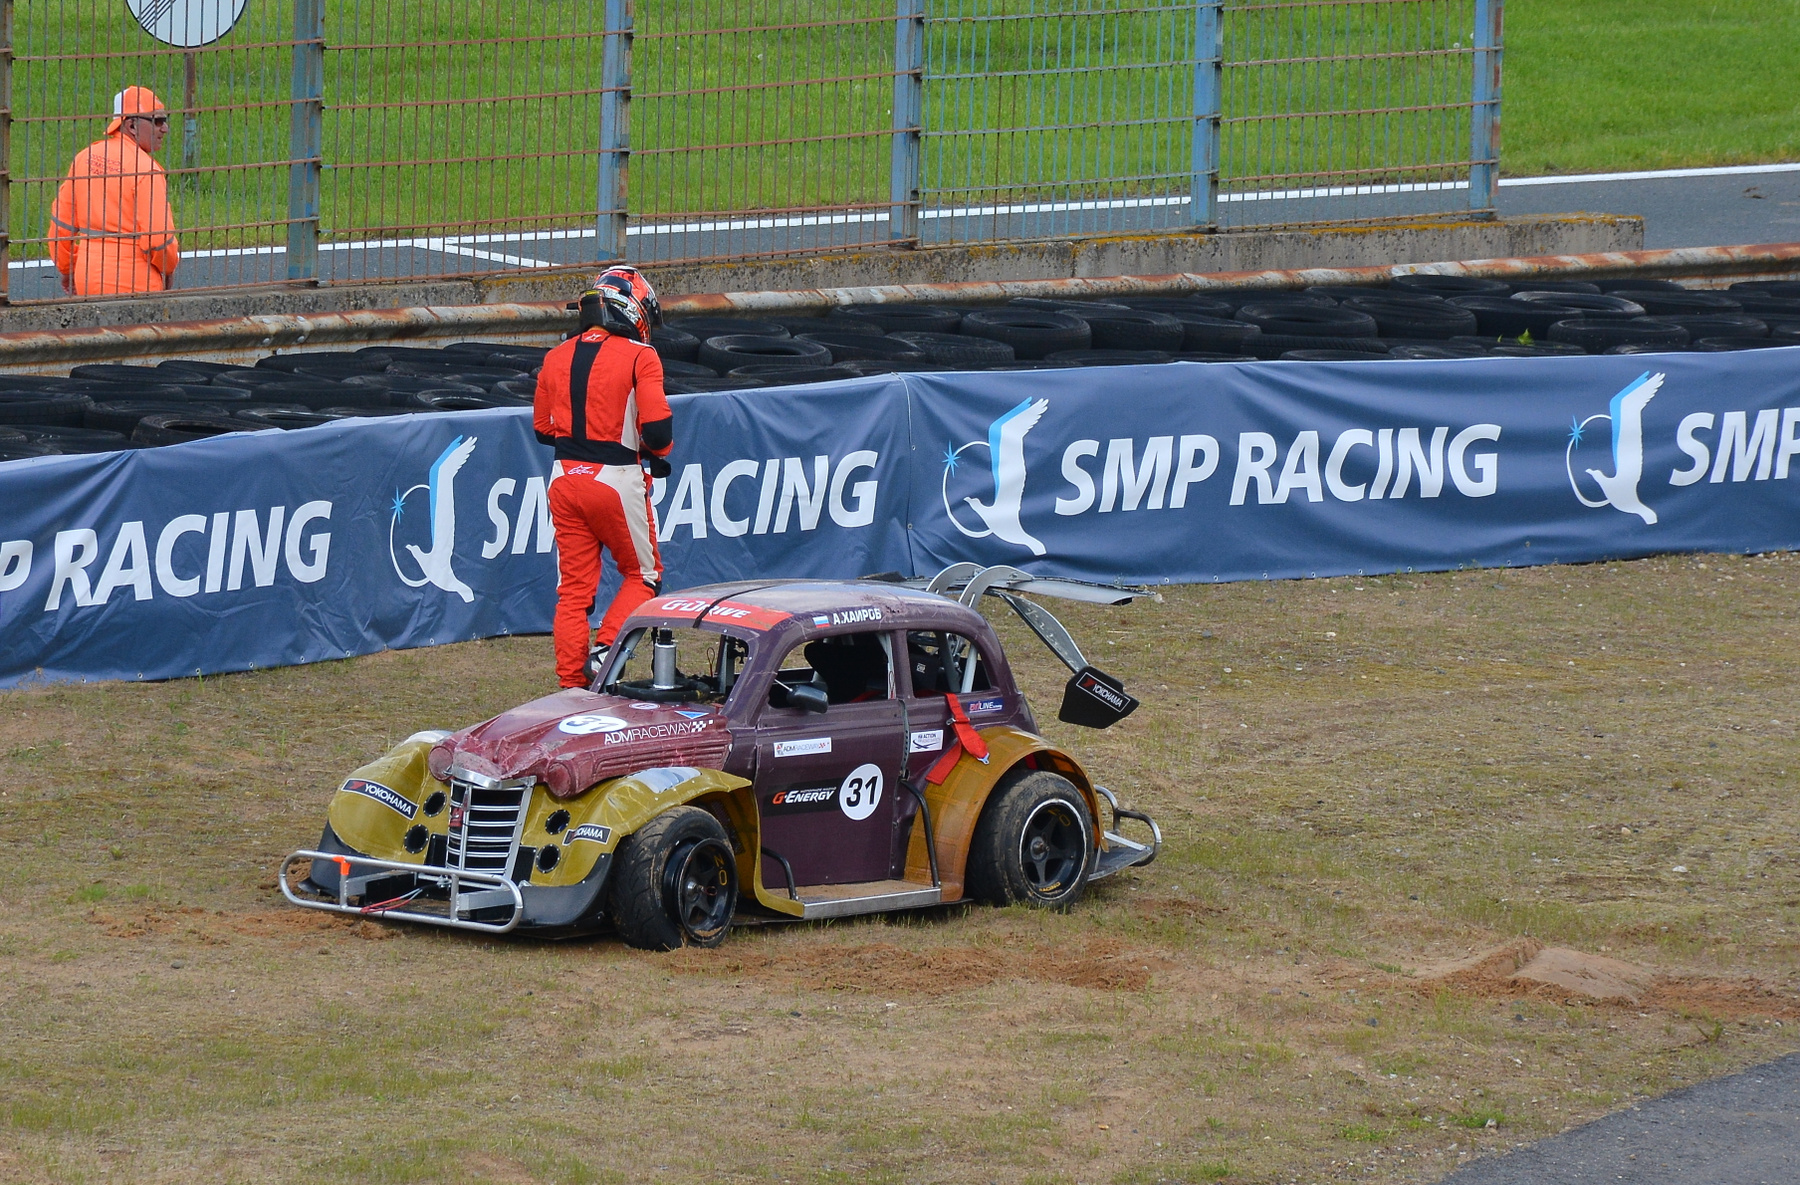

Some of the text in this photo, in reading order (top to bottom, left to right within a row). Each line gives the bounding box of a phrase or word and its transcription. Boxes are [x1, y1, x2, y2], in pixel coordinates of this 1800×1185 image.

[1055, 424, 1502, 516] SMP RACING
[482, 475, 557, 560] SM
[45, 501, 333, 612] RACING
[1092, 683, 1124, 708] YOKOHAMA
[566, 716, 618, 732] 31
[363, 783, 412, 816] YOKOHAMA
[846, 775, 879, 808] 31
